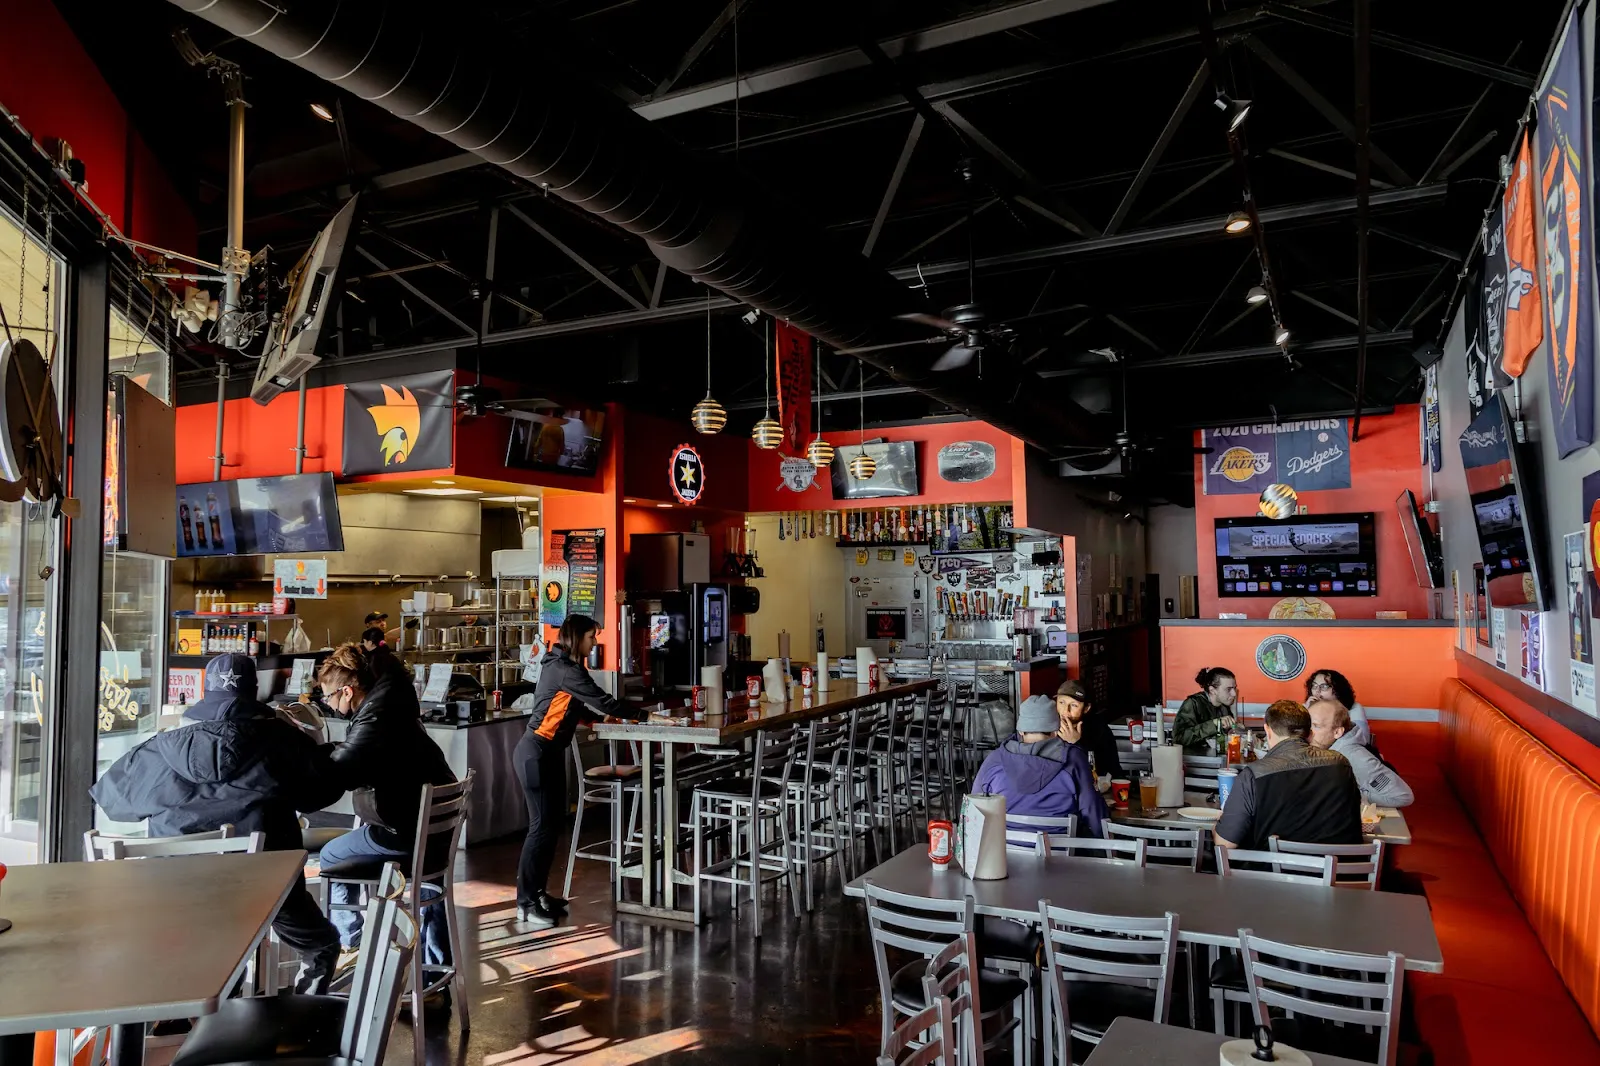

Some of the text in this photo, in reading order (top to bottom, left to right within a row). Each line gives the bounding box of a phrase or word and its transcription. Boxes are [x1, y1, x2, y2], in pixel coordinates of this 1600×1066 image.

[1213, 419, 1340, 437] 2020 CHAMPIONS
[1211, 456, 1270, 474] LAKERS
[1287, 445, 1343, 476] Dodgers
[1252, 533, 1332, 547] SPECIAL FORCES
[940, 558, 961, 569] TCU
[168, 675, 195, 686] EER ON
[168, 687, 195, 699] AM USA
